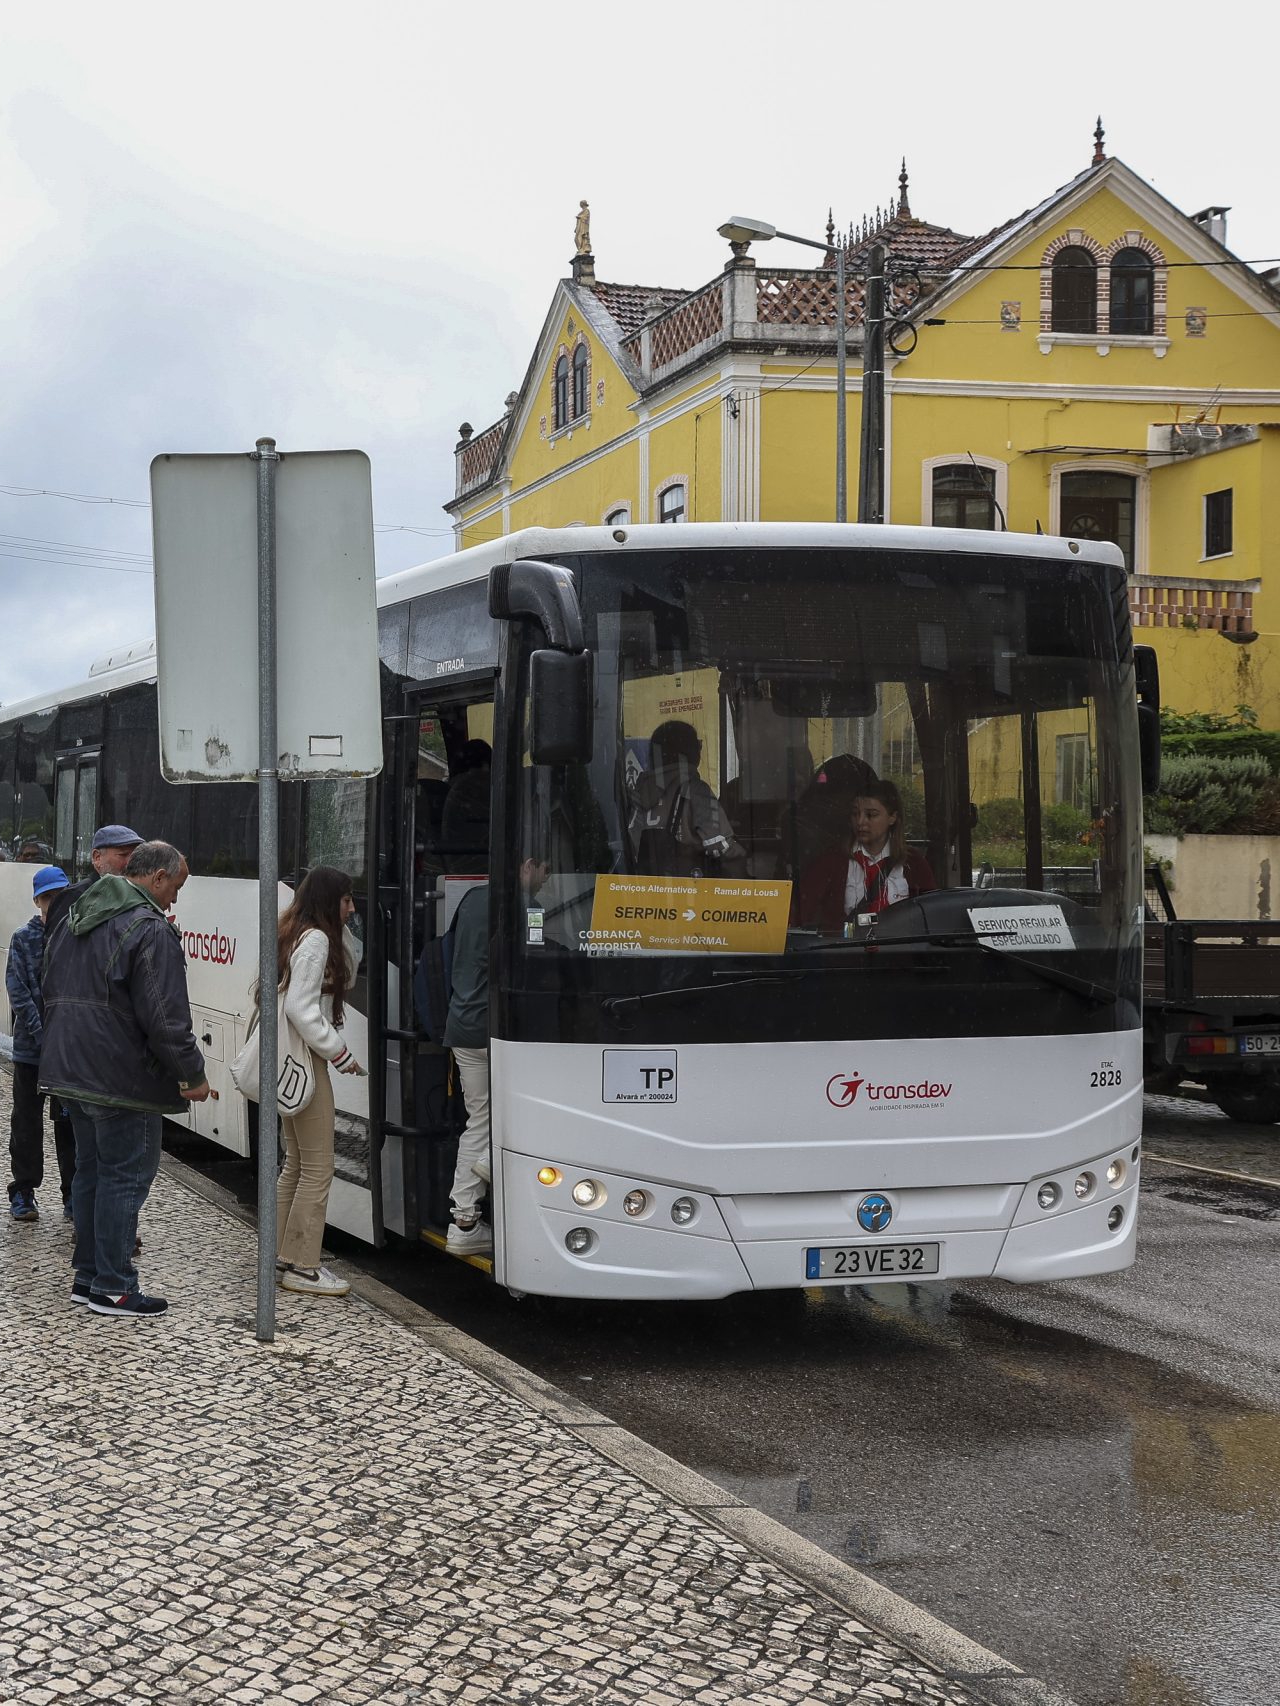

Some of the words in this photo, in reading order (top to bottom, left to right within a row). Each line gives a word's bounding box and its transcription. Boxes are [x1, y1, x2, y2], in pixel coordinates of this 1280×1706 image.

[436, 658, 465, 674] ENTRADA
[609, 883, 646, 893] Serviços
[648, 884, 697, 894] Alternativos
[714, 887, 739, 896] Ramal
[741, 888, 751, 896] da
[753, 888, 779, 897] Lousã
[615, 907, 677, 920] SERPINS
[701, 910, 768, 923] COIMBRA
[978, 918, 1018, 931] SERVIÇO
[1020, 917, 1062, 928] REGULAR
[579, 930, 642, 940] COBRANÇA
[682, 935, 728, 946] NORMAL
[991, 934, 1061, 946] ESPECIALIZADO
[178, 923, 236, 965] ransdev
[579, 942, 642, 951] MOTORISTA
[639, 1068, 674, 1089] TP
[1090, 1070, 1122, 1087] 2828
[865, 1080, 953, 1100] transdev
